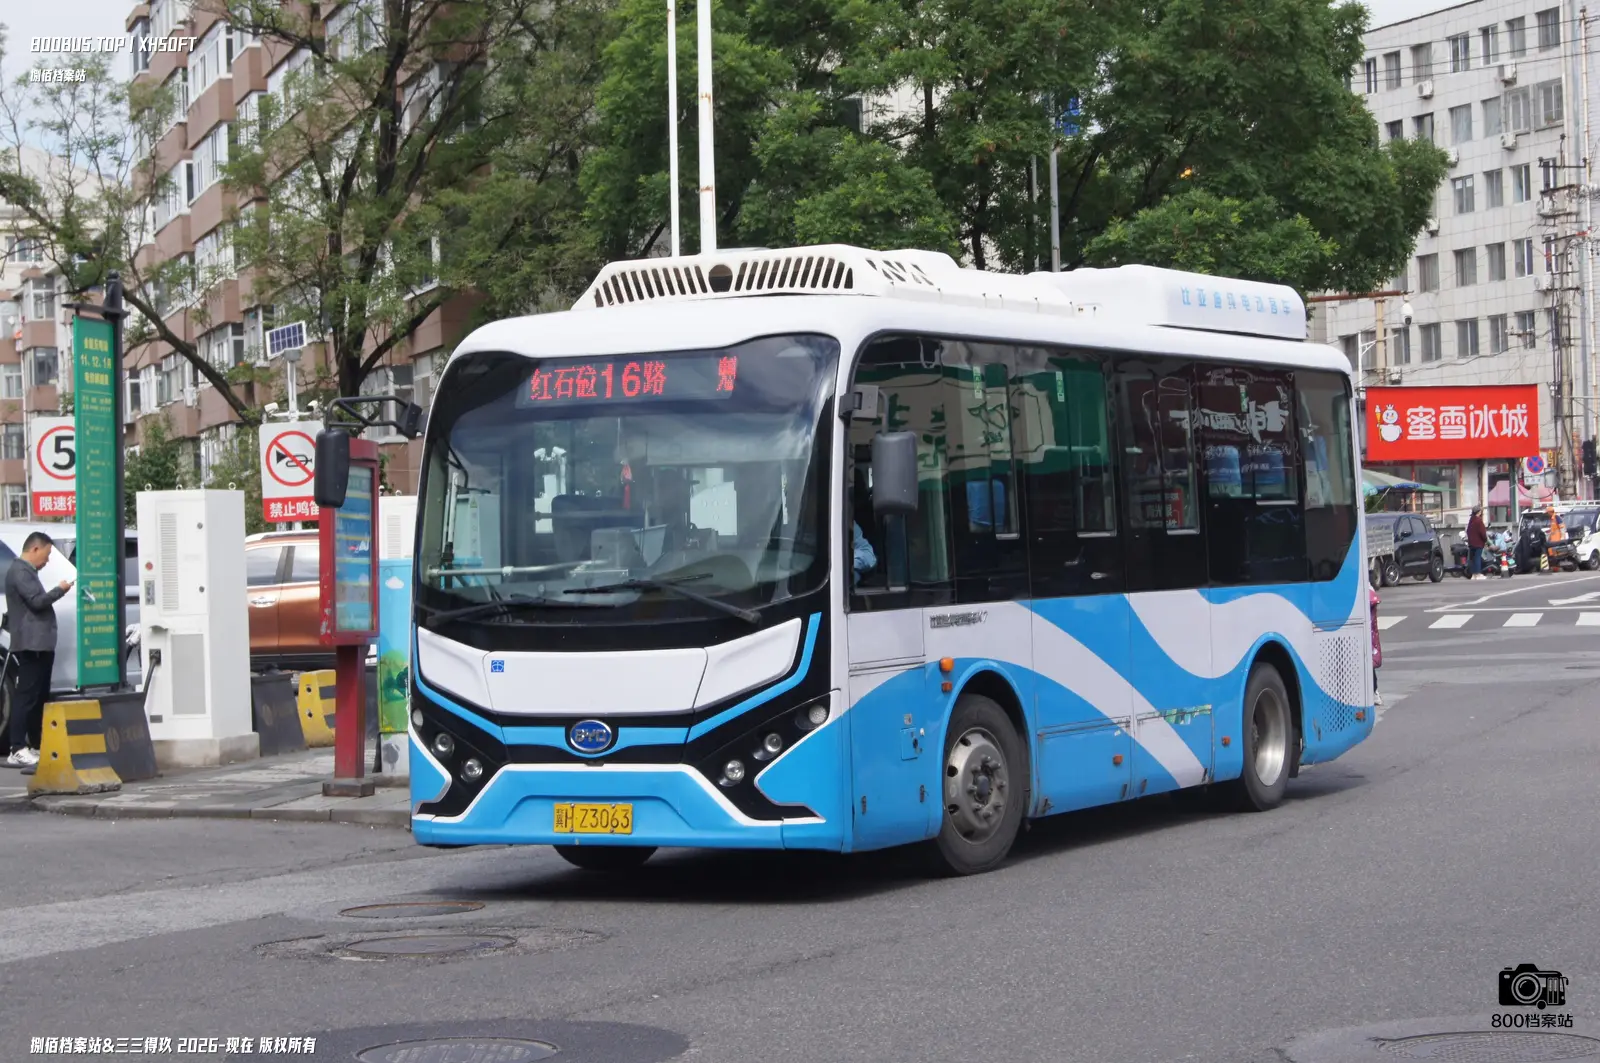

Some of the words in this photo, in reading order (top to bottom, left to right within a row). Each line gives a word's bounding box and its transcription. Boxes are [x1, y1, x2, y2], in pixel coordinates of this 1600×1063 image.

[1406, 403, 1529, 440] 蜜雪冰城
[52, 435, 76, 470] 5
[269, 500, 320, 518] 禁止鸣笛
[574, 728, 607, 743] BYD
